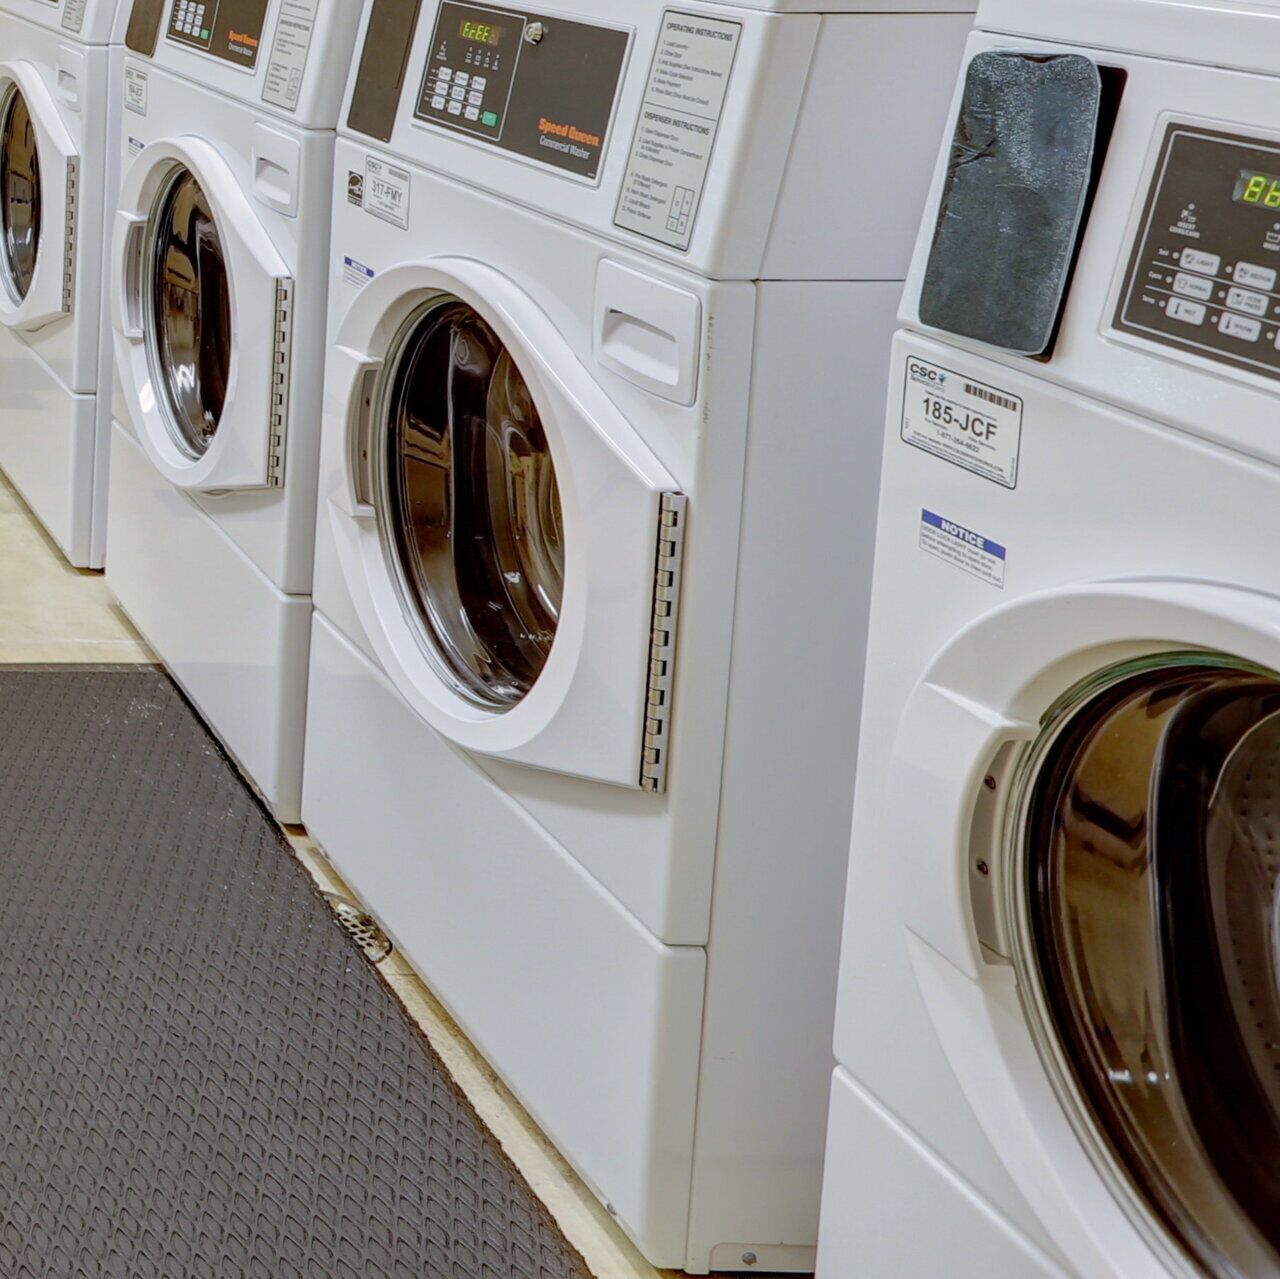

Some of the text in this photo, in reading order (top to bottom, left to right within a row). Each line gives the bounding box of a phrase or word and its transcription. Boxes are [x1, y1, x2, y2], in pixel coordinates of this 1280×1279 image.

[539, 118, 599, 146] Speed Queen
[570, 144, 590, 159] Washer
[372, 180, 402, 204] 317-FMY
[1158, 248, 1169, 257] Soil
[1148, 271, 1162, 280] Cycle
[910, 362, 936, 381] CSC
[922, 395, 997, 444] 185-JCF
[940, 519, 984, 549] NOTICE
